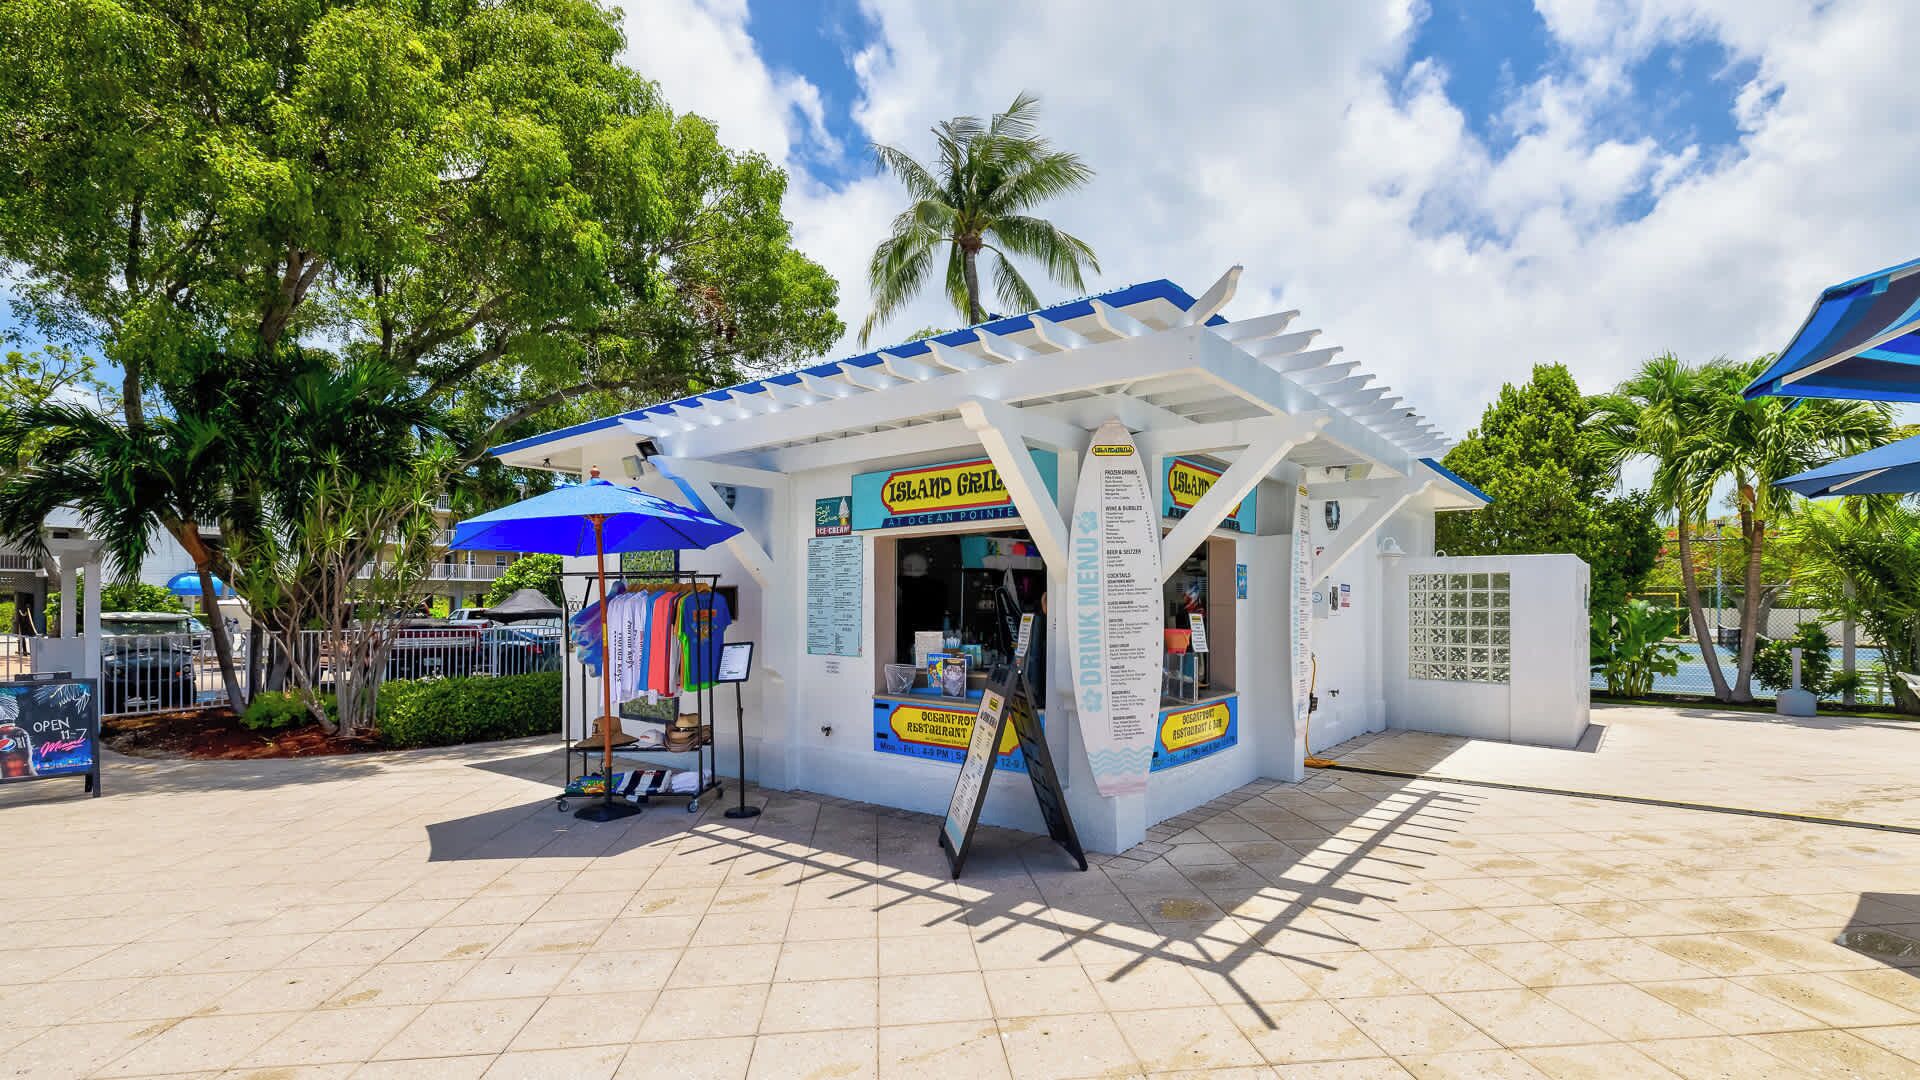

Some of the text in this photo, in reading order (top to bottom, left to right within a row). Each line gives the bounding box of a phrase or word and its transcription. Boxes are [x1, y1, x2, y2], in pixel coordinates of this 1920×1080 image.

[889, 469, 1007, 504] ISLAND GRIL
[889, 509, 1014, 527] AT OCEAN POINTE
[816, 525, 850, 535] ICE CREAM
[1076, 538, 1102, 686] DRINK MENU
[33, 717, 70, 733] OPEN
[921, 711, 977, 729] OCEANFRON
[907, 722, 968, 739] RESTAURANT
[1172, 720, 1207, 741] RESTAURANT
[936, 749, 949, 759] PM
